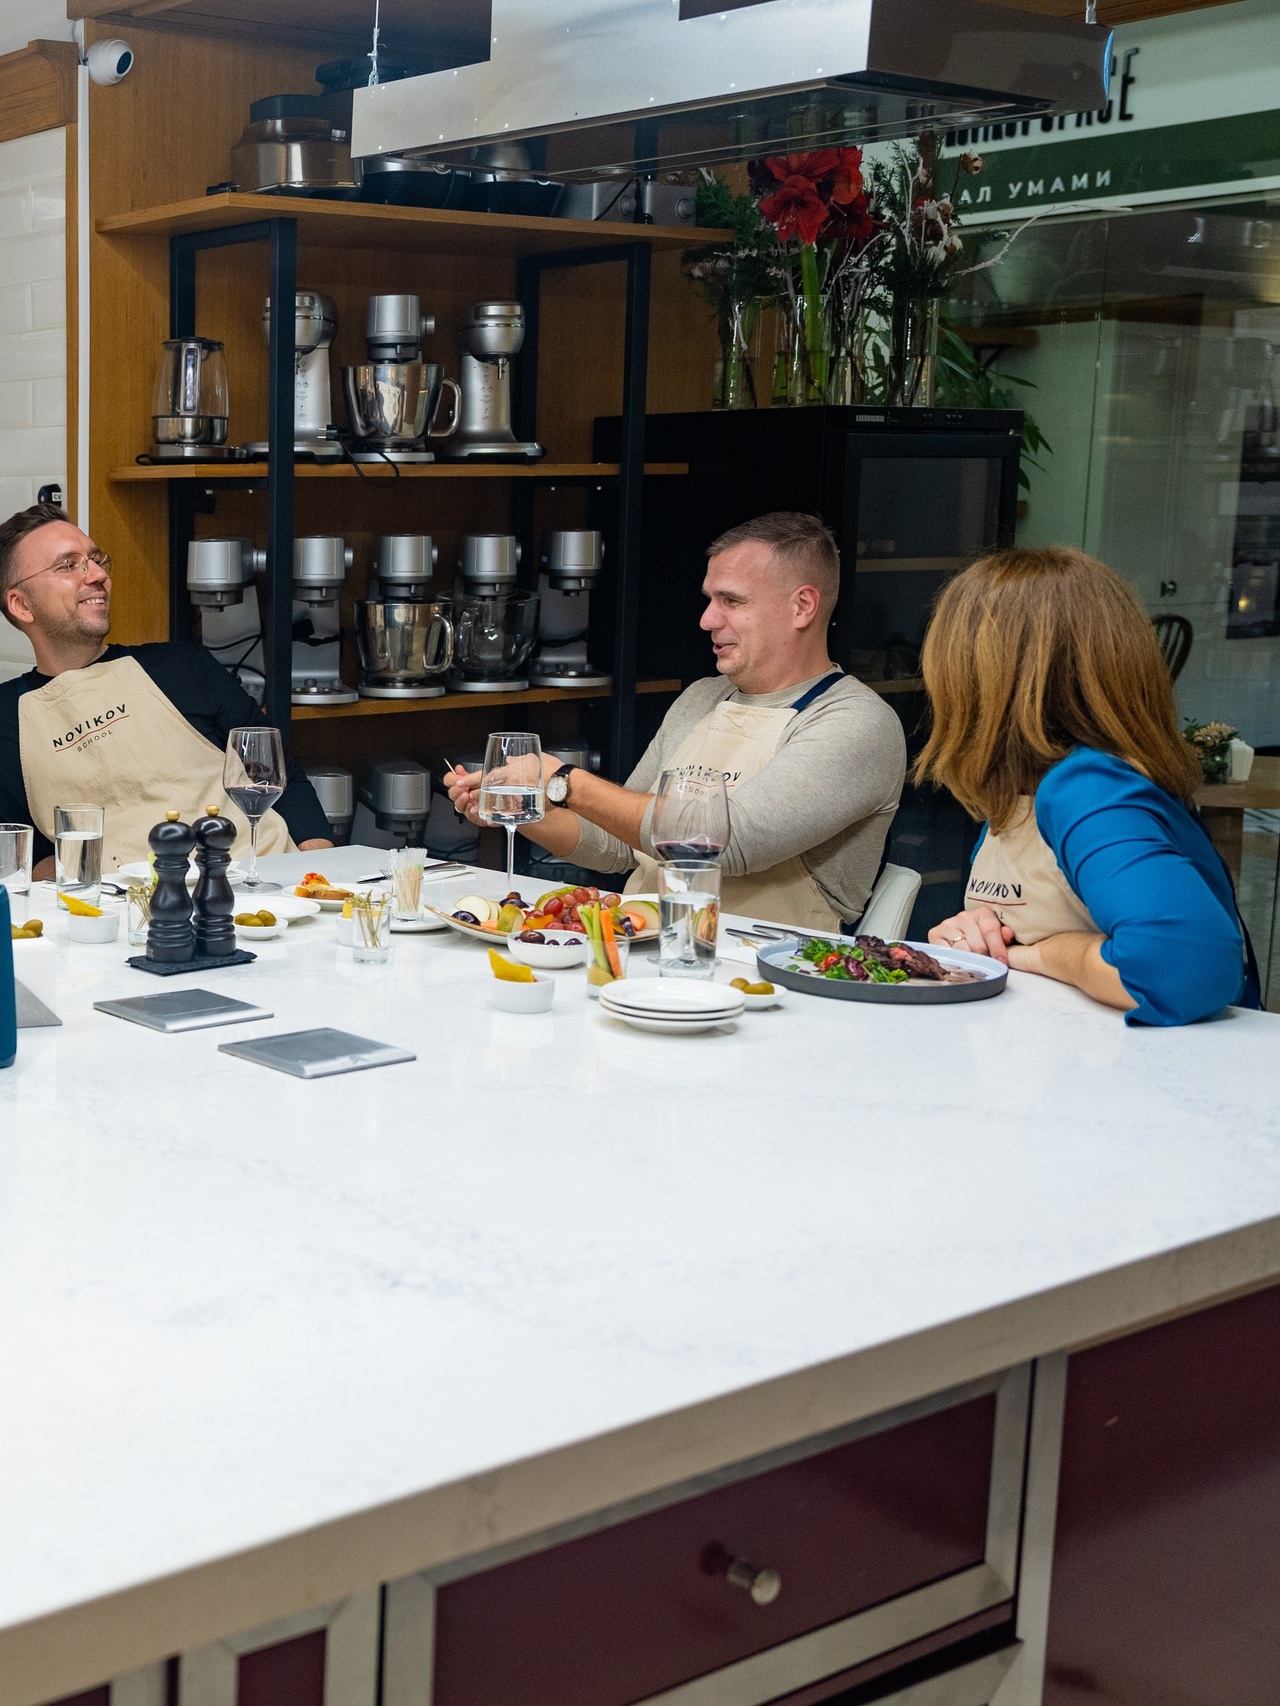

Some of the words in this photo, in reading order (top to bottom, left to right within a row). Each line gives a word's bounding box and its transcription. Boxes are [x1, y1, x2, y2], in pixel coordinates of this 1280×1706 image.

[1007, 169, 1112, 199] УМАМИ
[52, 703, 126, 748] NOVIKOV
[77, 729, 113, 752] SCHOOL
